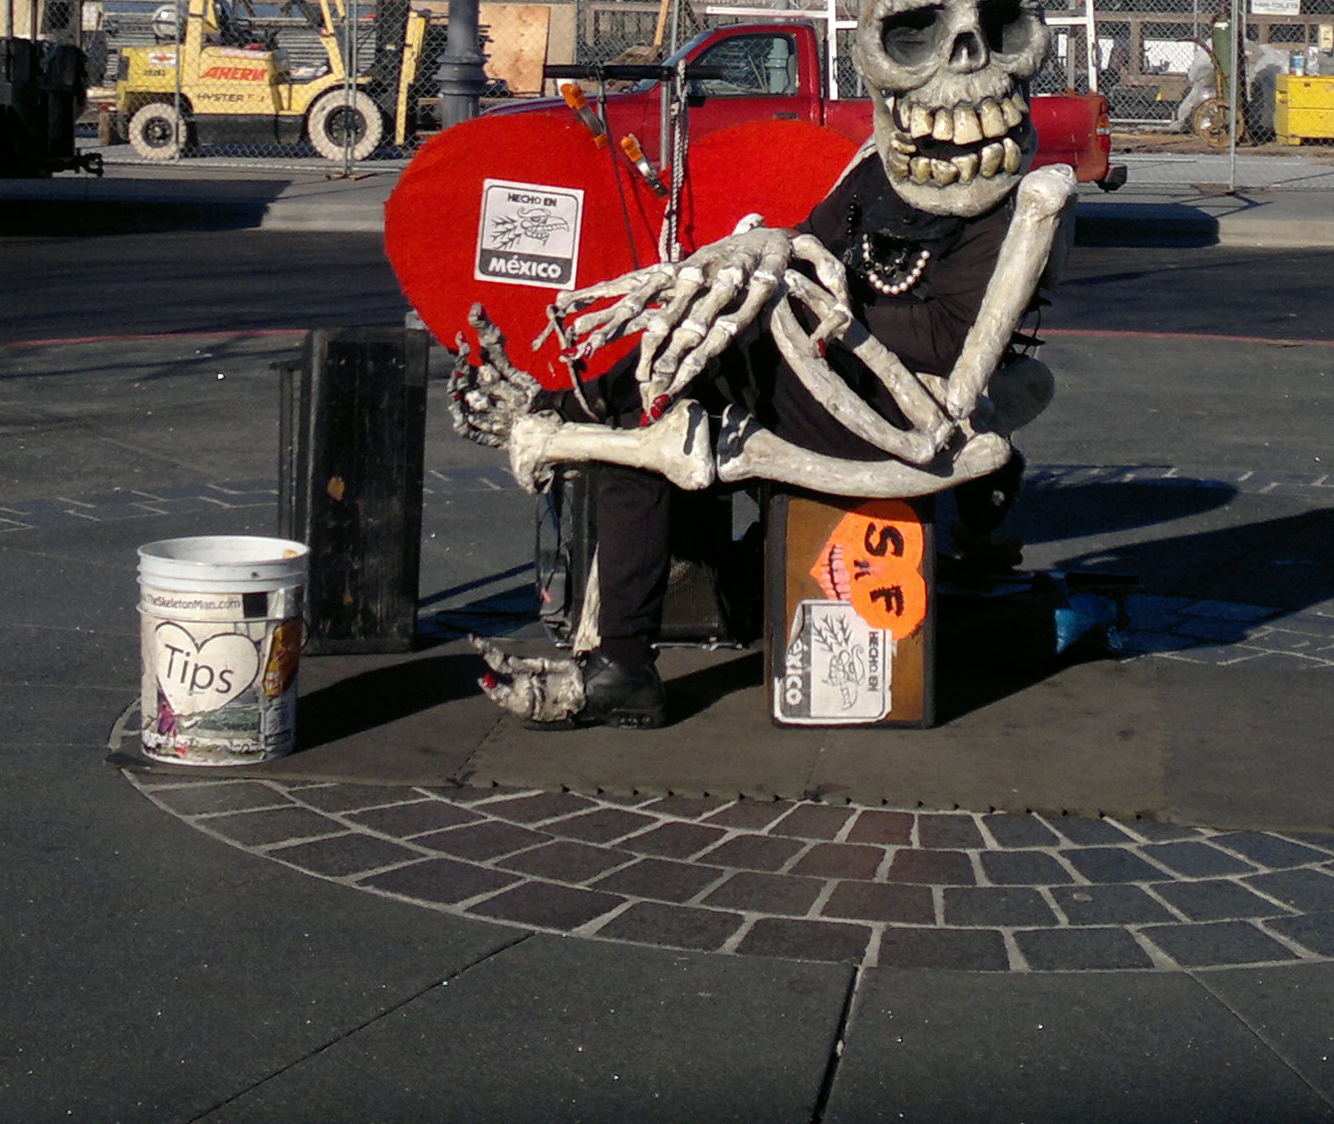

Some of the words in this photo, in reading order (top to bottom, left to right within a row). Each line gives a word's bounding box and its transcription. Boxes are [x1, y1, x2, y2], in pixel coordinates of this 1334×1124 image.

[197, 92, 244, 103] HYSTER
[507, 192, 541, 205] HECHO
[543, 197, 557, 207] EN
[868, 630, 880, 674] HECHO
[165, 643, 235, 697] Tips
[867, 676, 879, 692] EN
